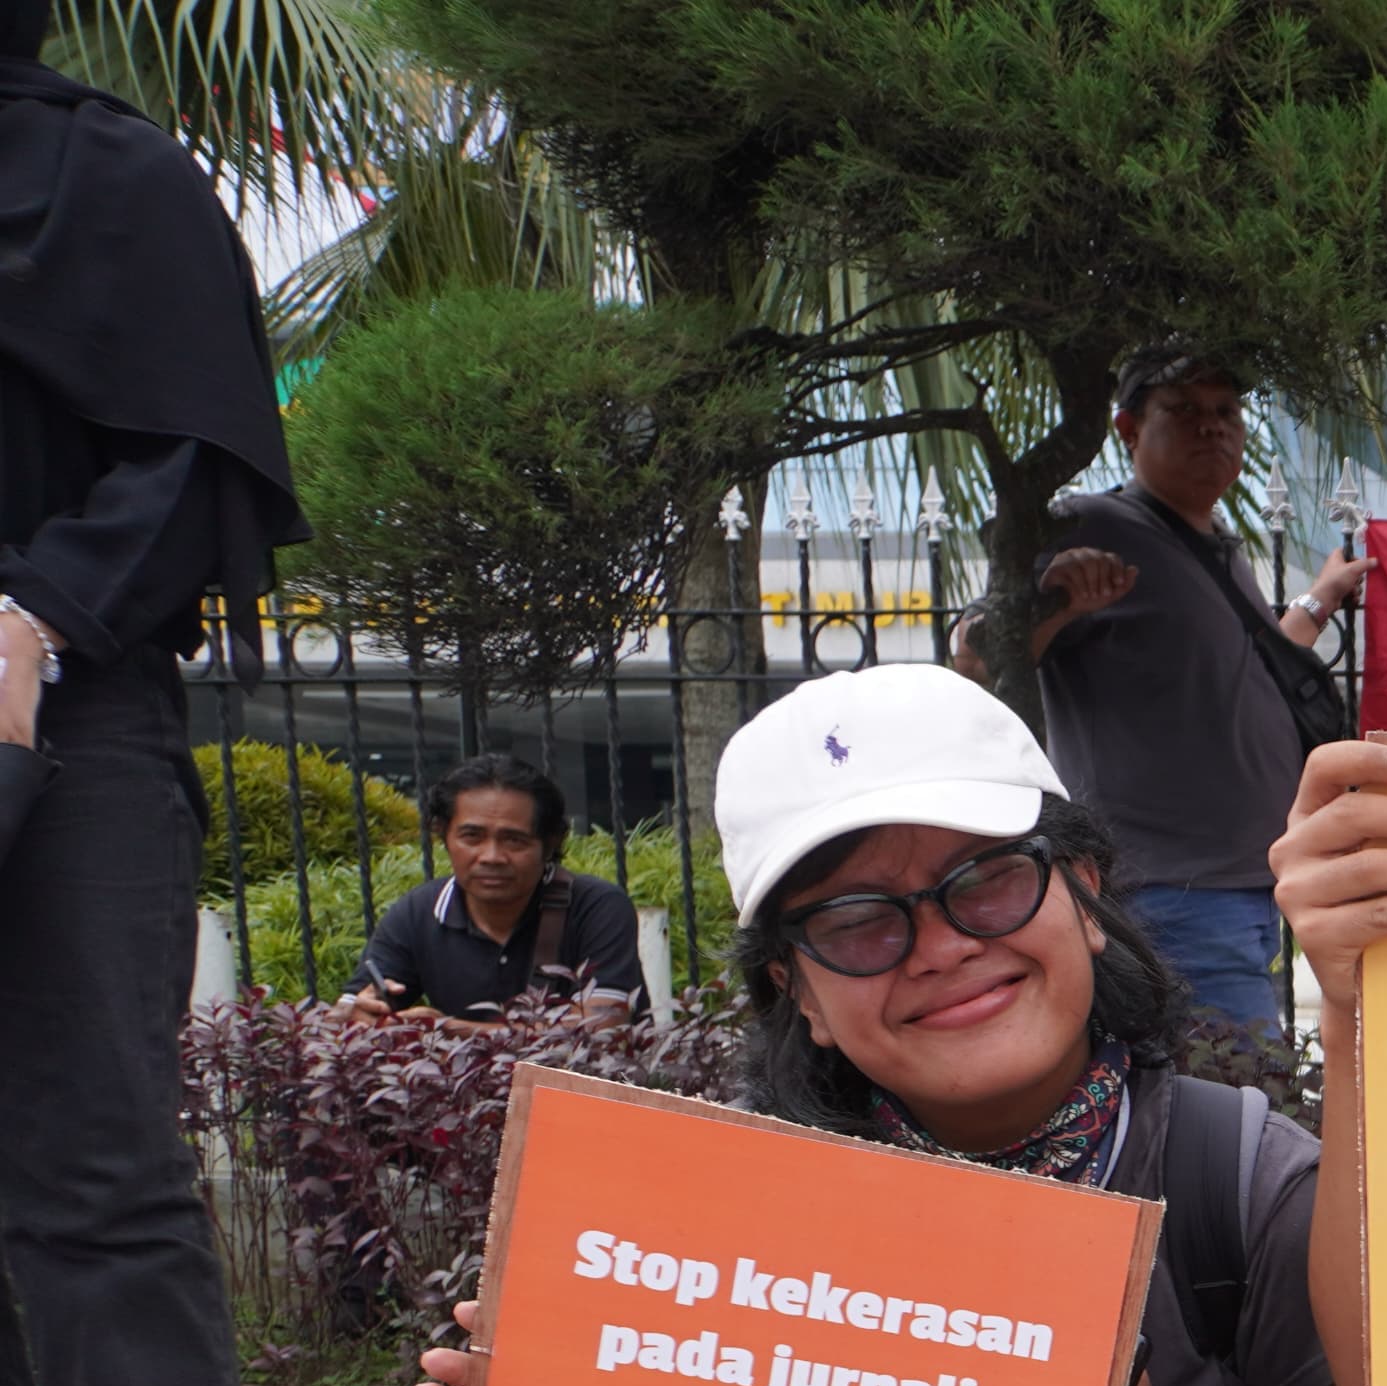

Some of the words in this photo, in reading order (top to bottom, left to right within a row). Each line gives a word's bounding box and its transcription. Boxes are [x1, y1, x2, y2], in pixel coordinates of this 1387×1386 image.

[574, 1230, 720, 1306] Stop
[730, 1257, 1054, 1361] kekerasan
[596, 1324, 755, 1386] pada
